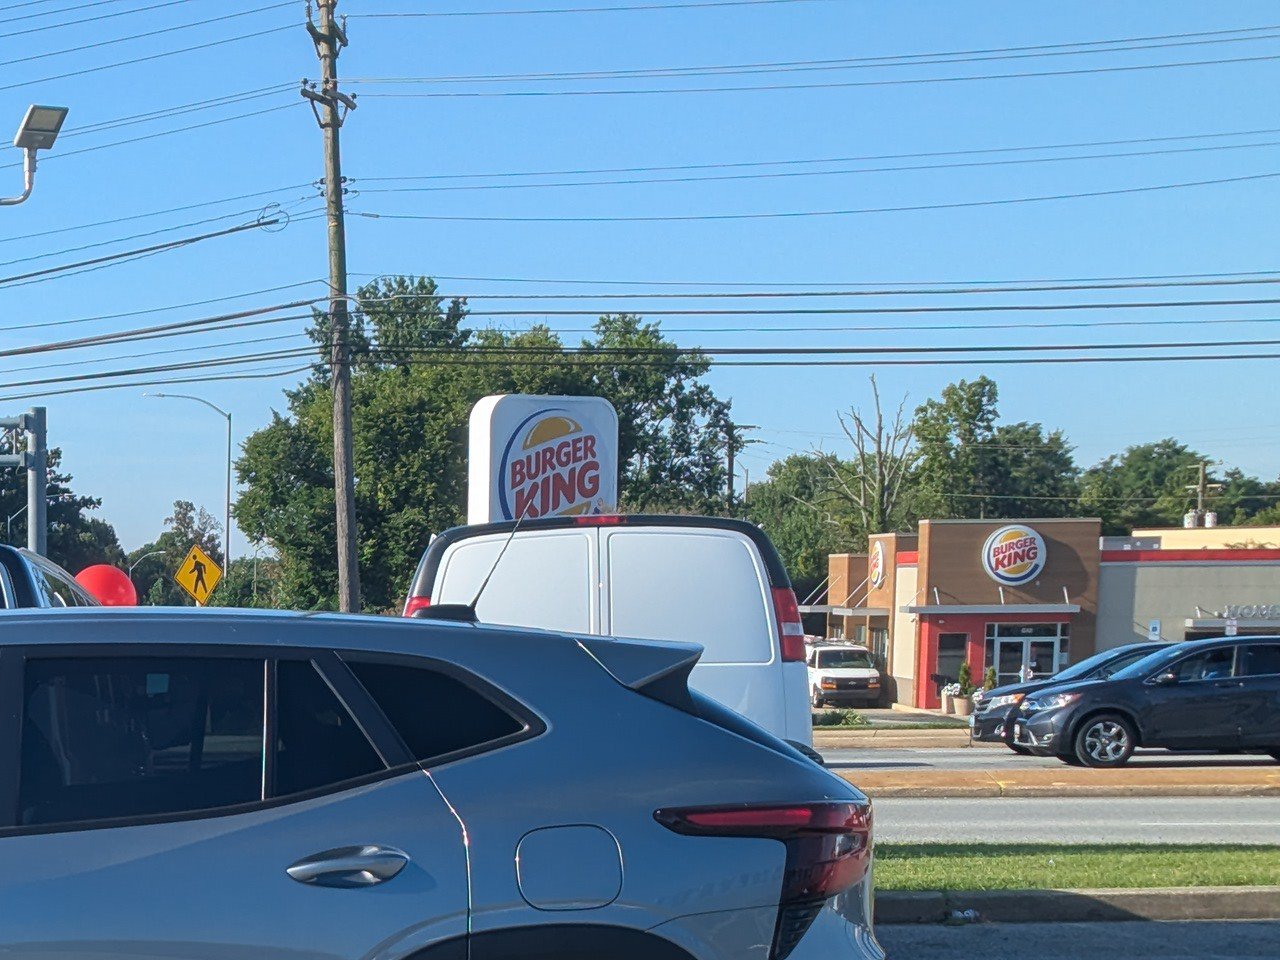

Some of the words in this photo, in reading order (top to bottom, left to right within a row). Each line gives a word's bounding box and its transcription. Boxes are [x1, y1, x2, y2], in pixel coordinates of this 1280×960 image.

[510, 435, 597, 490] BURGER
[515, 461, 600, 520] KING
[993, 537, 1037, 558] BURGER
[995, 547, 1038, 572] KING
